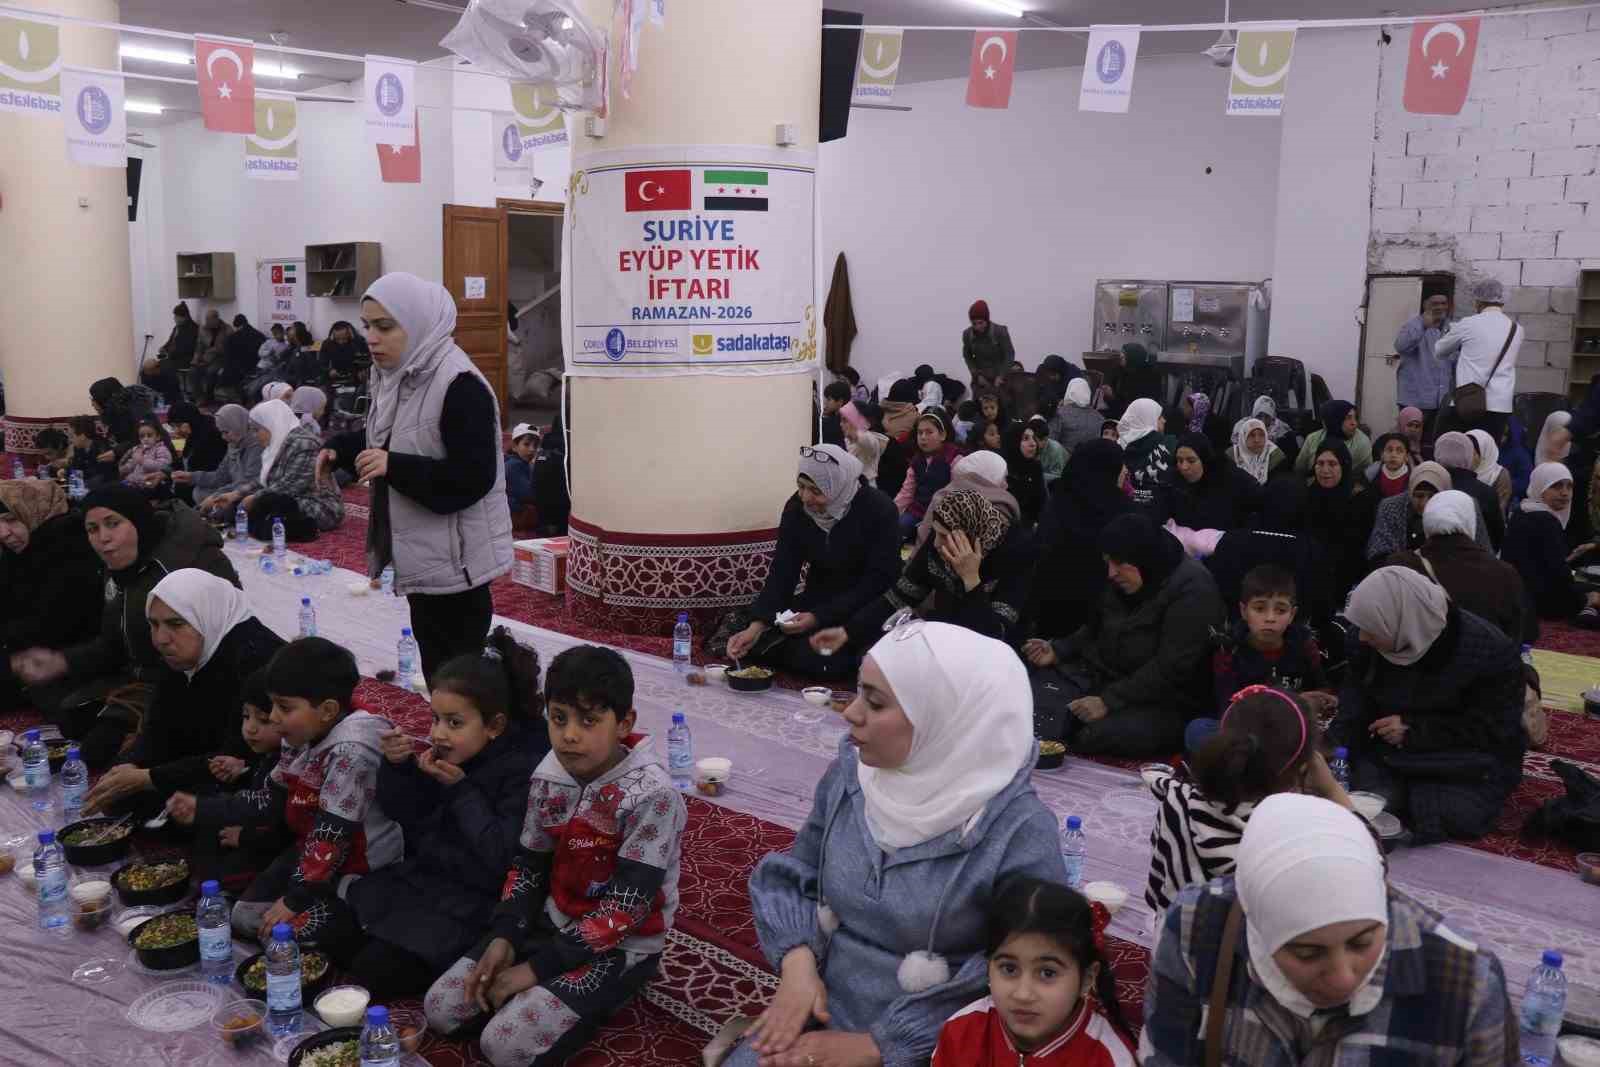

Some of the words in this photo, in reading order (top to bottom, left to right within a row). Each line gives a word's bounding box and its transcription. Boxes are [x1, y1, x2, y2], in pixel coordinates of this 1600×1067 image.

[643, 215, 735, 242] SURİYE
[619, 245, 682, 272] EYÜP
[690, 244, 760, 270] YETİK
[649, 274, 730, 300] İFTARI
[632, 305, 753, 320] RAMAZAN-2026
[626, 336, 679, 349] BELEDİYESİ
[716, 333, 790, 352] sadakataşı
